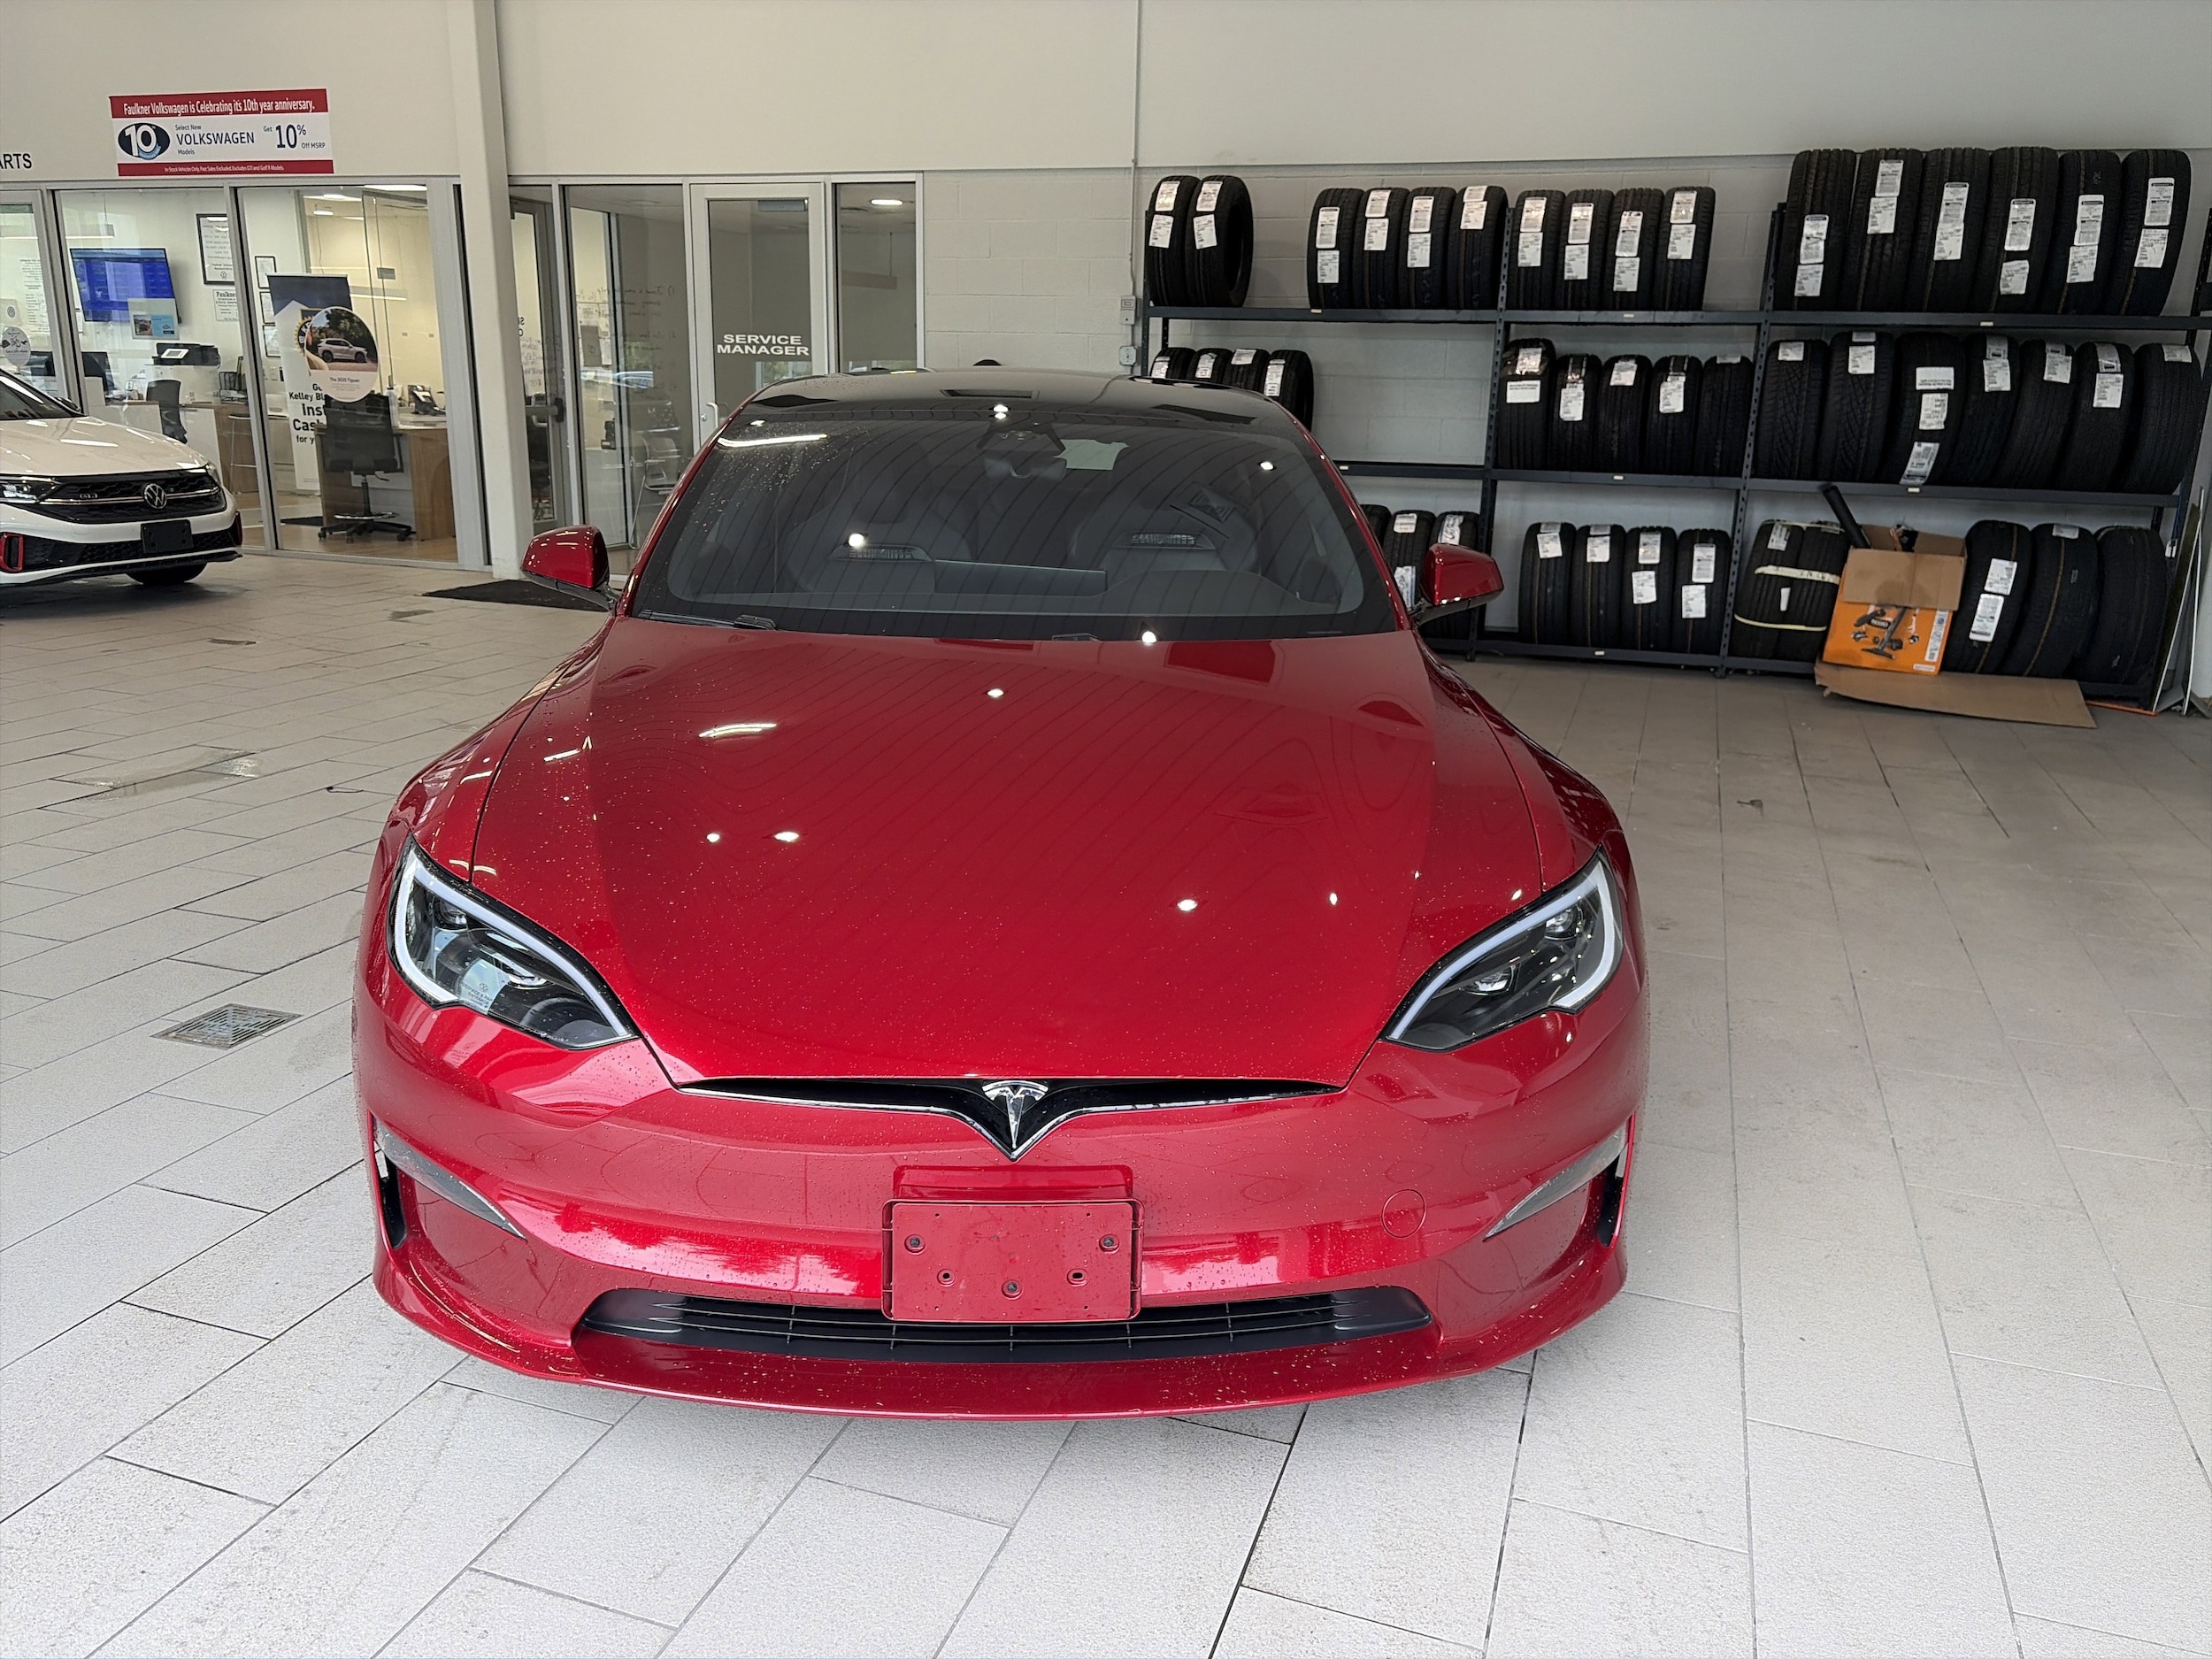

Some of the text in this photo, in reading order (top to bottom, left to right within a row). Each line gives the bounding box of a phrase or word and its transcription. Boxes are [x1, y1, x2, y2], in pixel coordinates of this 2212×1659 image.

[123, 103, 150, 115] Faulkner
[150, 101, 188, 116] Volkswagen
[189, 101, 196, 113] is
[196, 98, 233, 114] Celebrating
[243, 98, 259, 111] 10th
[259, 100, 273, 114] year
[274, 97, 316, 112] anniversary.
[125, 124, 157, 157] 10
[176, 132, 255, 145] VOLKSWAGEN
[723, 334, 803, 345] SERVICE
[717, 344, 810, 356] MANAGER
[288, 392, 313, 402] Kelley
